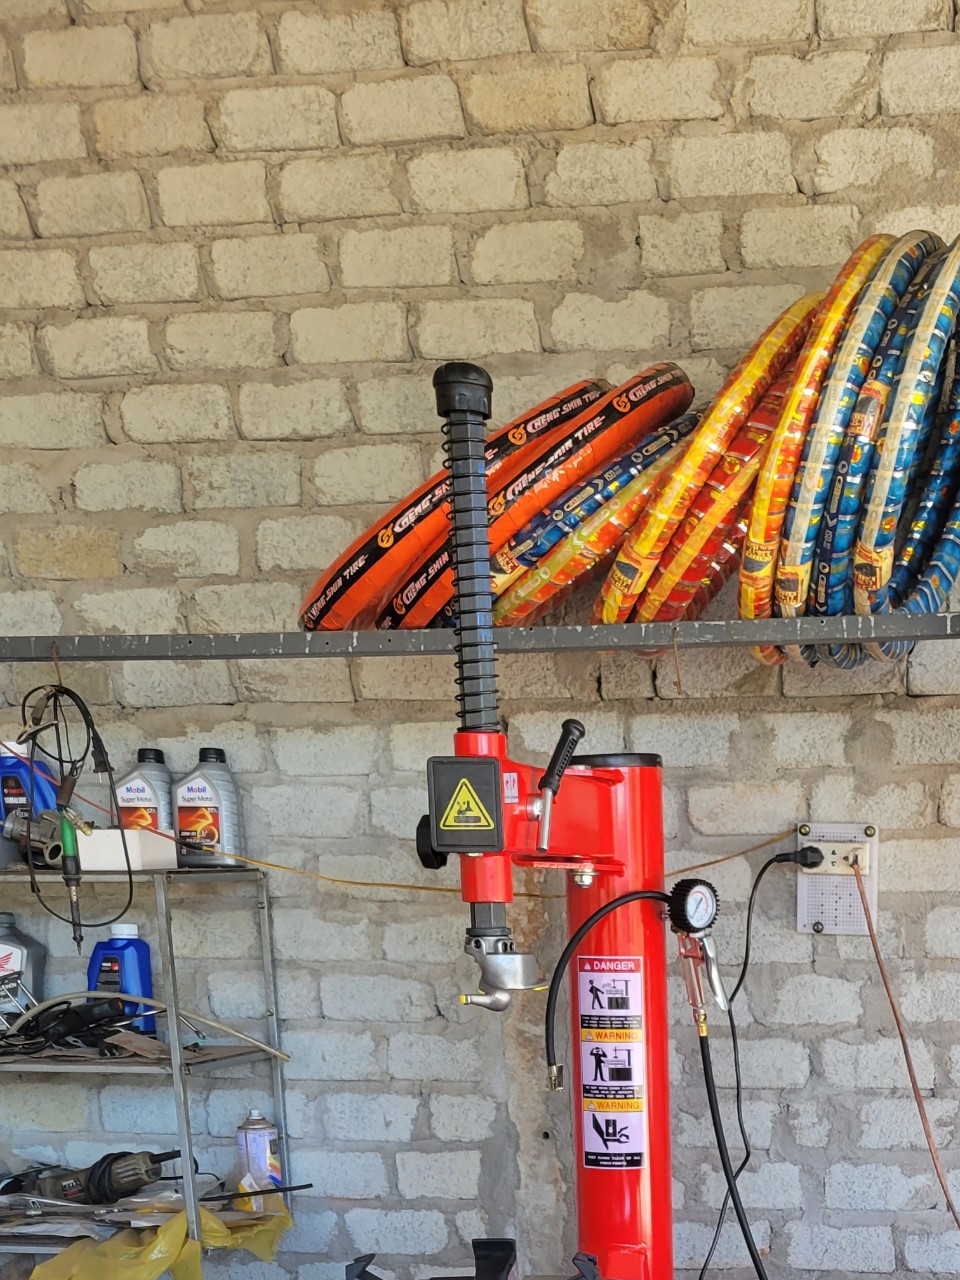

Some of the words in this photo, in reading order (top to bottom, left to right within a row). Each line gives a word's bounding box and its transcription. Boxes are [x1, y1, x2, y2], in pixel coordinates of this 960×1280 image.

[526, 407, 560, 433] CHENG
[561, 398, 583, 415] SHIN
[574, 415, 606, 441] TIRE
[343, 554, 369, 580] TIRE
[402, 572, 428, 605] CHENG
[427, 551, 450, 580] SHIN
[125, 786, 146, 794] Mobil
[593, 961, 636, 971] DANGER
[595, 1031, 637, 1040] WARNING
[596, 1101, 640, 1110] WARNING
